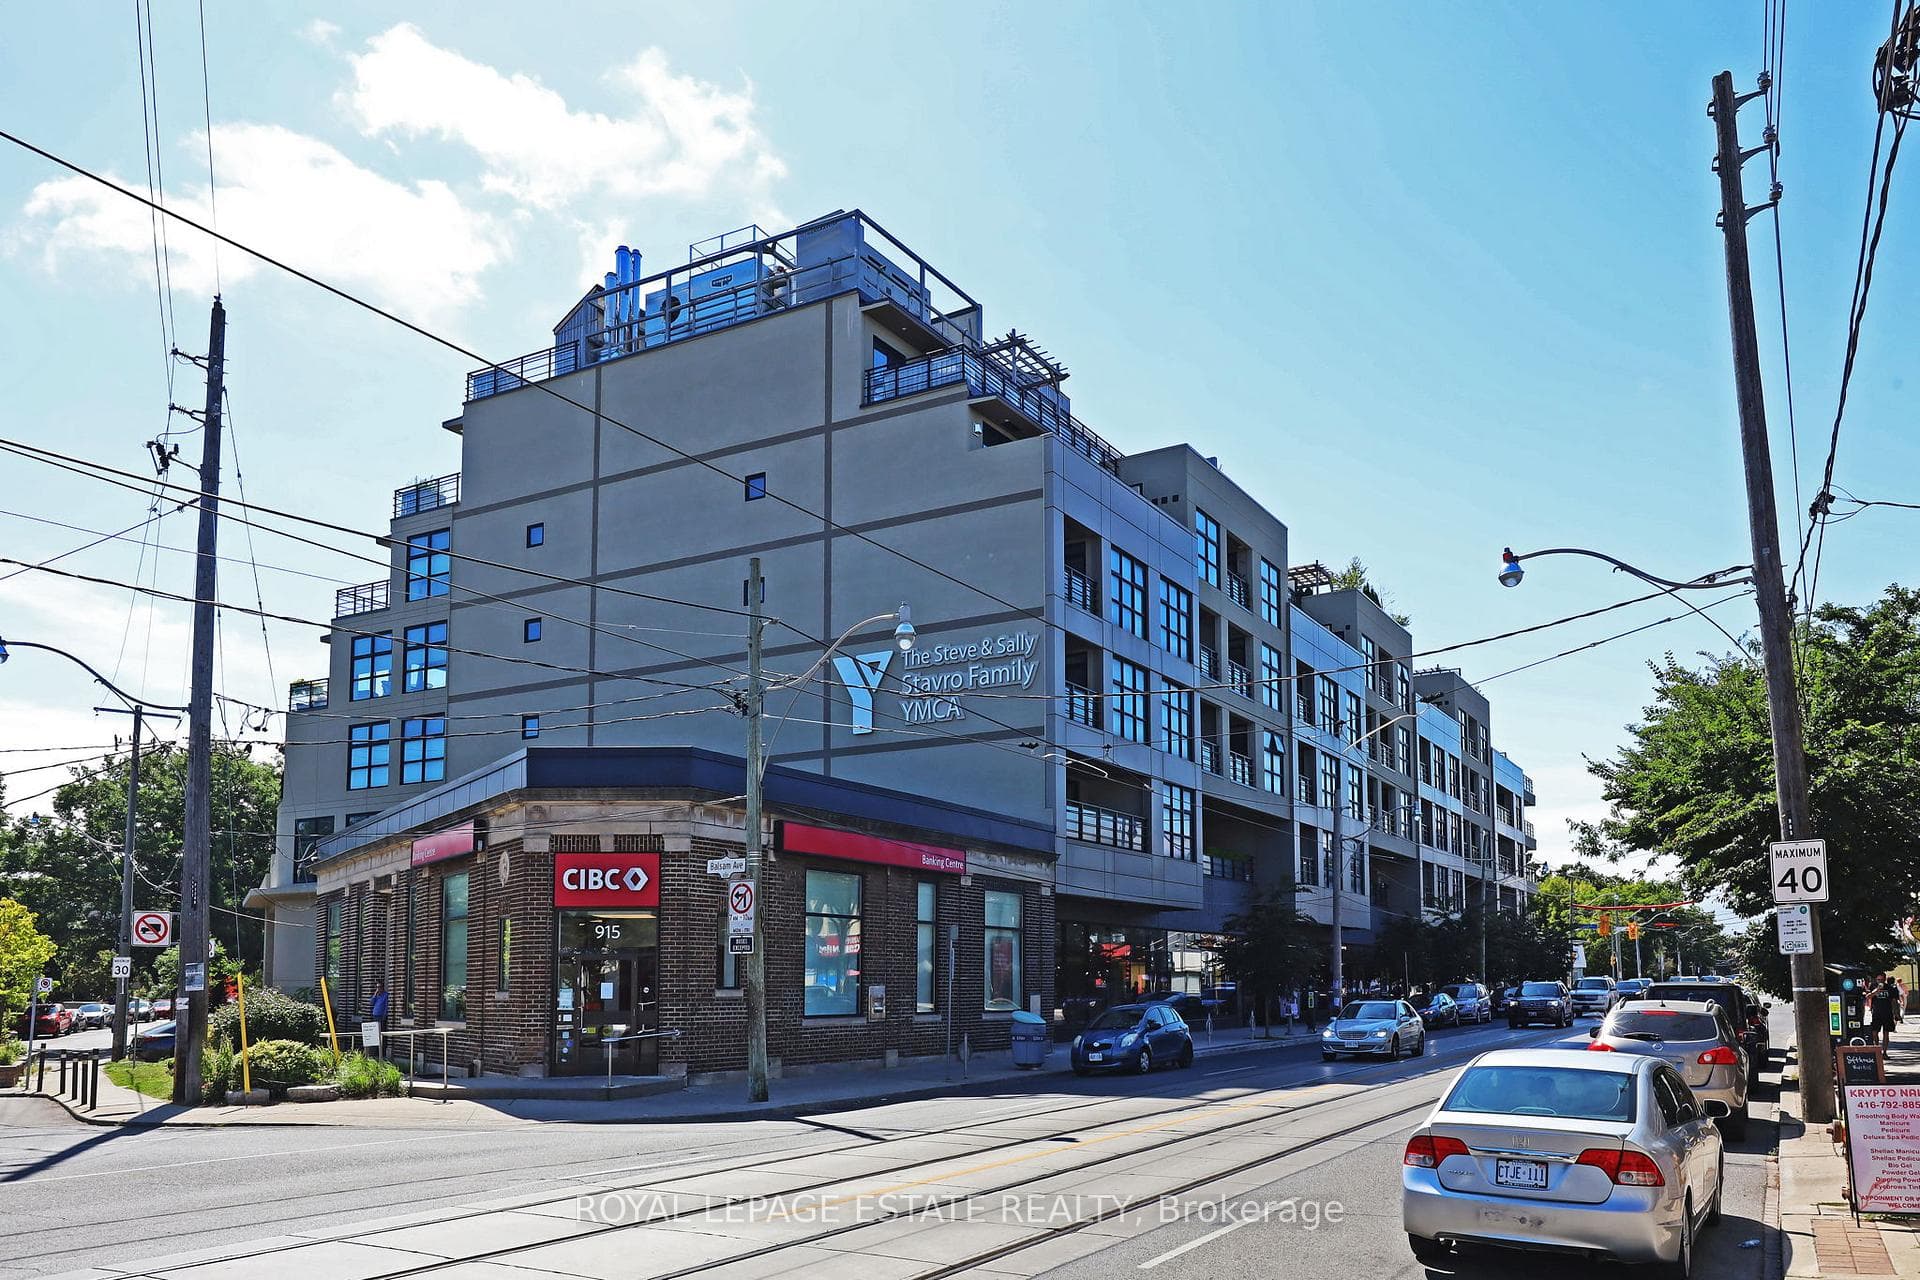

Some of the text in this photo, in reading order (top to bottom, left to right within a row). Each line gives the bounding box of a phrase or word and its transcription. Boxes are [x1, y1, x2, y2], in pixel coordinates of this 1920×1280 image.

[902, 634, 1034, 667] The Steve & Sally
[902, 658, 1034, 694] Stavro Family
[901, 697, 960, 721] YMCA
[1775, 847, 1820, 859] MAXIMUM
[710, 861, 743, 870] Balsam Ave
[922, 854, 964, 870] Banking Centre
[562, 868, 620, 890] CIBC
[1777, 866, 1822, 893] 40
[595, 925, 621, 939] 915
[114, 965, 129, 975] 30
[1850, 1089, 1896, 1097] KRYPTO
[1857, 1101, 1920, 1109] 416-792-885
[1498, 1165, 1544, 1181] CTJE 111
